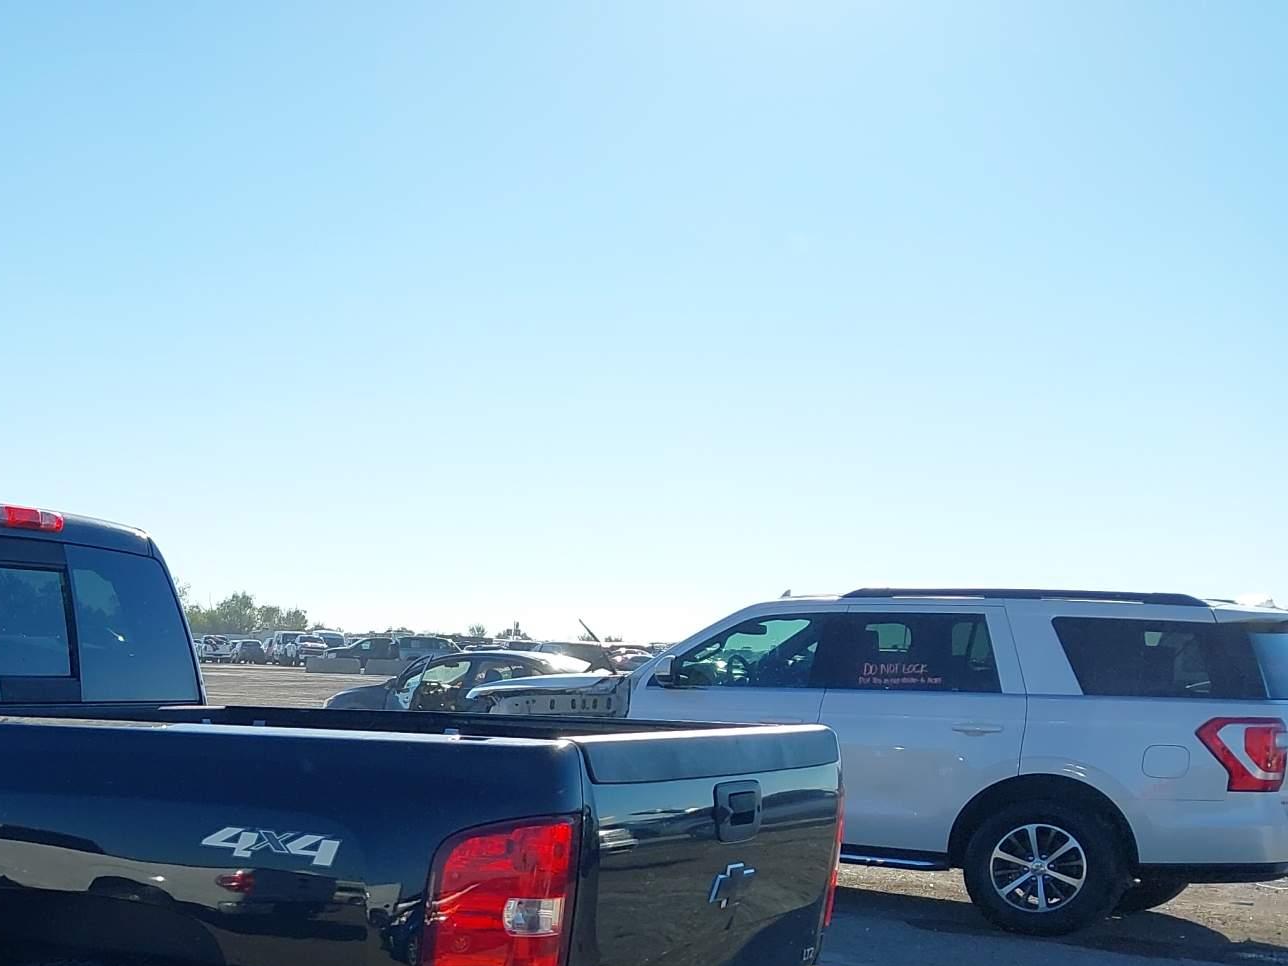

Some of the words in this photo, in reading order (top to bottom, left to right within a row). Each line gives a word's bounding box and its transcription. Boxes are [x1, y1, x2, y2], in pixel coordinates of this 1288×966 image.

[863, 663, 878, 676] DO
[880, 663, 899, 675] NOT
[902, 663, 928, 674] LOCK
